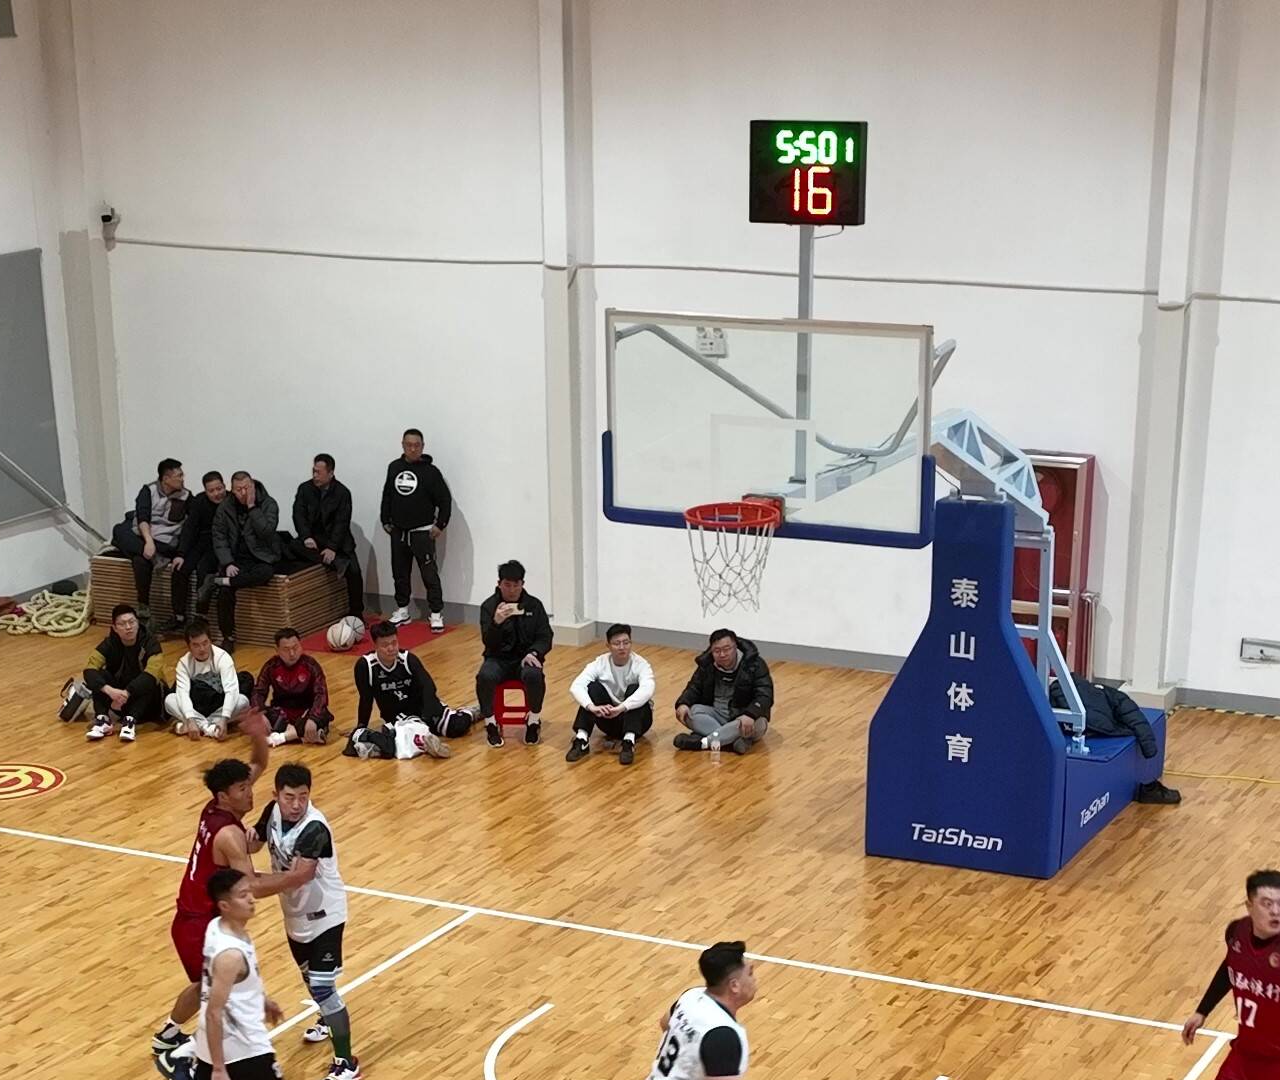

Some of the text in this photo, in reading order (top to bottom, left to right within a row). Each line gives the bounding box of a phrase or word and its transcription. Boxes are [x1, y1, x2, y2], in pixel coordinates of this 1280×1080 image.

[793, 165, 832, 215] 16
[944, 578, 980, 764] 泰山体育
[1079, 791, 1111, 828] TaiShan
[911, 823, 1003, 852] TaiShan
[1236, 996, 1258, 1029] 17
